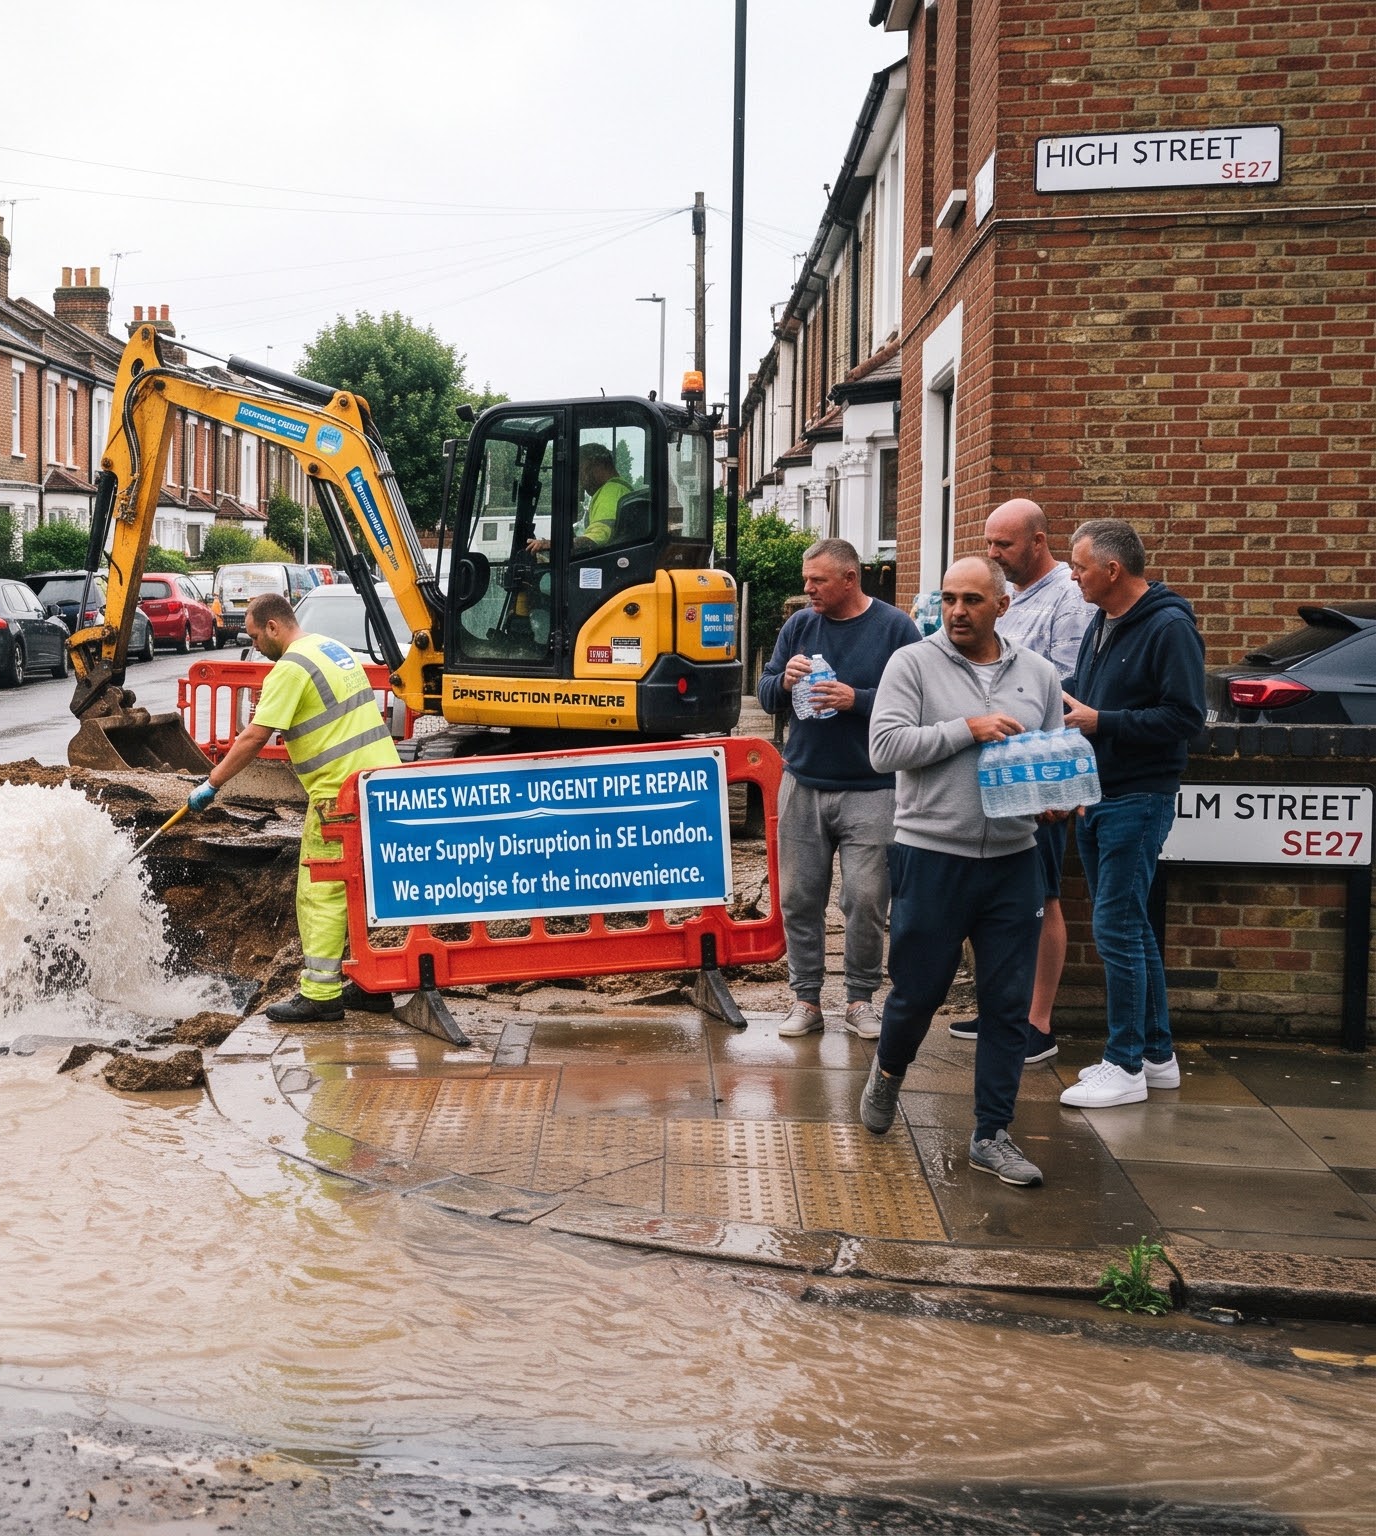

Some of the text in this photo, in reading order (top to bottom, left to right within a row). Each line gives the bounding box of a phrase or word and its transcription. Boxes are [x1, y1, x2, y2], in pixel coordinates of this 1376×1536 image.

[1046, 136, 1243, 168] HIGH STREET
[1221, 161, 1272, 179] SE27
[374, 787, 447, 812] THAMES
[451, 783, 511, 807] WATER
[527, 777, 598, 803] URGENT
[603, 774, 642, 798] PIPE
[645, 770, 709, 794] REPAIR
[1177, 792, 1361, 821] LM STREET
[380, 822, 713, 865] Water Supply Disruption in SE London.
[1281, 830, 1363, 857] SE27
[392, 862, 706, 906] We apologise for the inconvenience.
